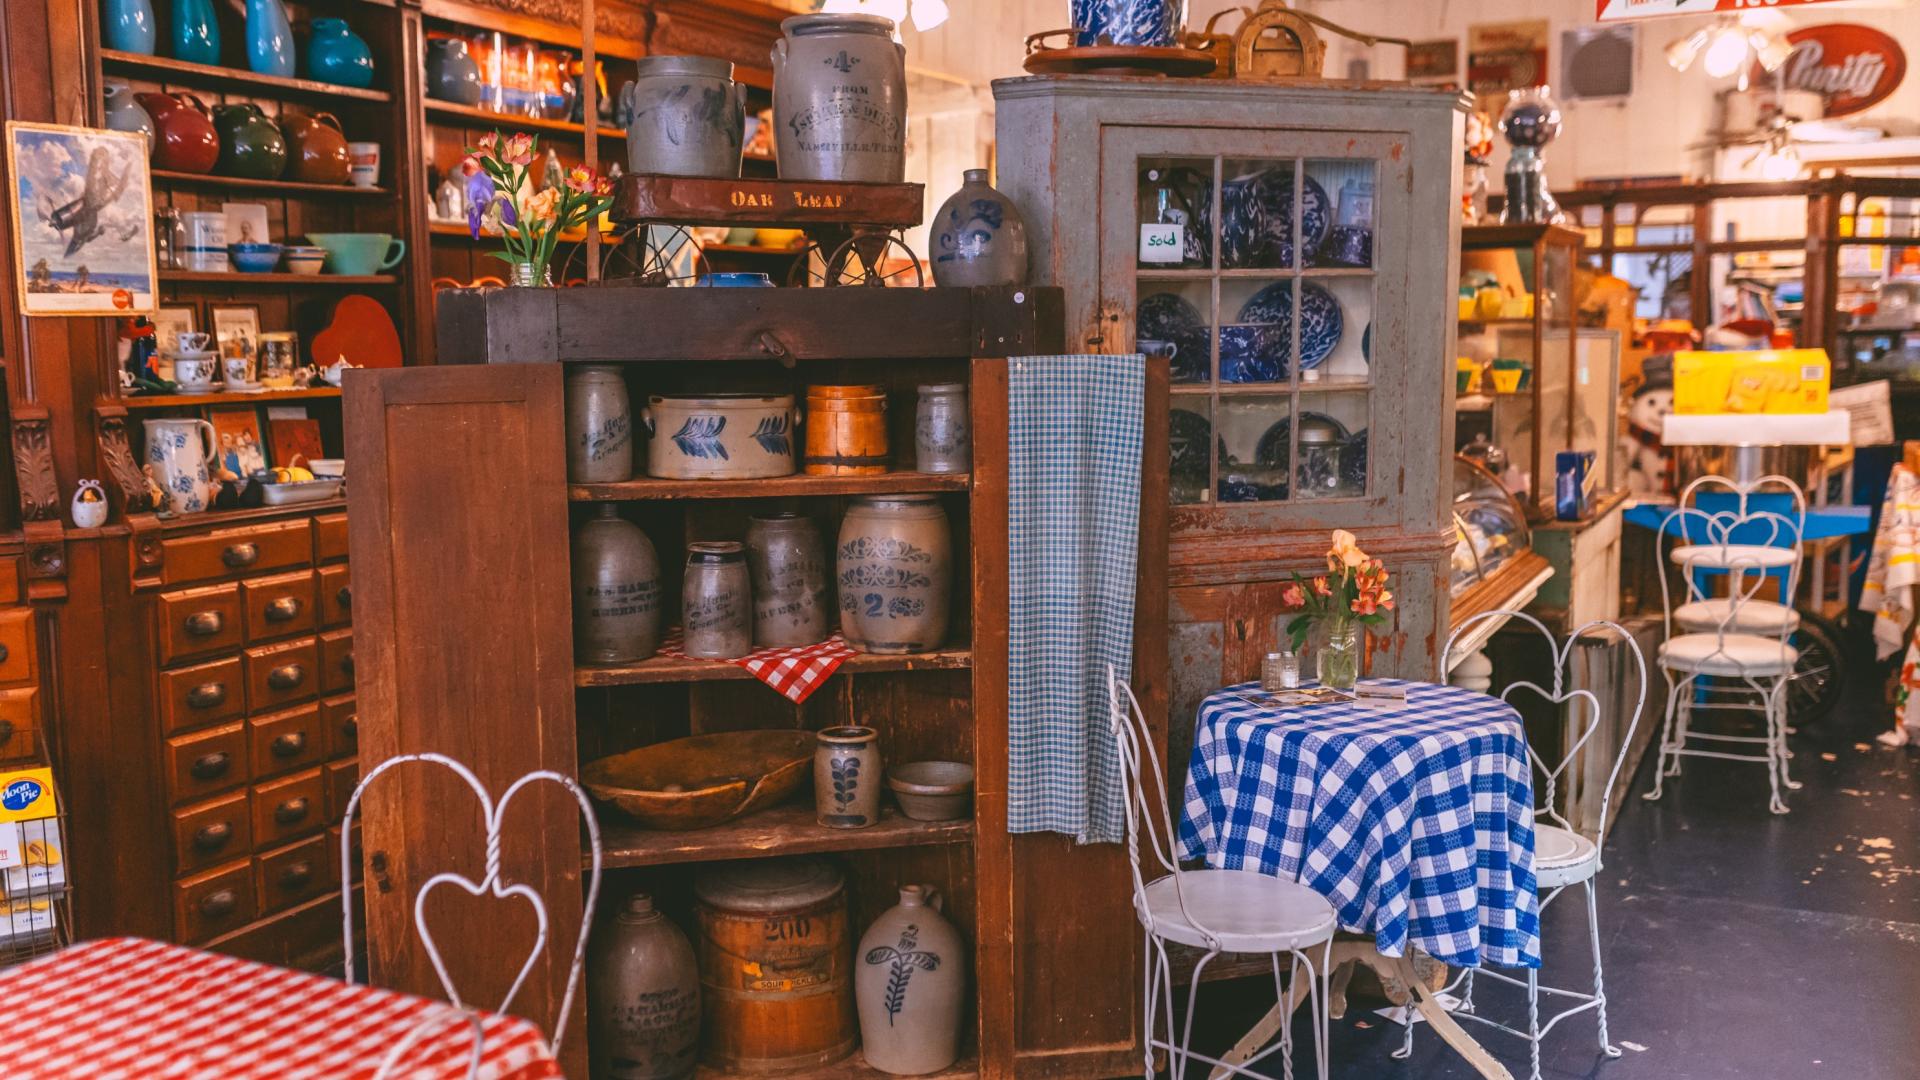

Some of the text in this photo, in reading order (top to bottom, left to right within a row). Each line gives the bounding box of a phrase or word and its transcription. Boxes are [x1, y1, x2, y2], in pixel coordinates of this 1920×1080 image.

[833, 50, 852, 73] 4
[1787, 39, 1885, 97] Purity
[832, 86, 869, 96] FROM
[731, 191, 773, 207] OAK
[864, 593, 884, 617] 2
[20, 789, 39, 803] Pie
[764, 918, 811, 940] 200
[761, 980, 784, 989] SOUR
